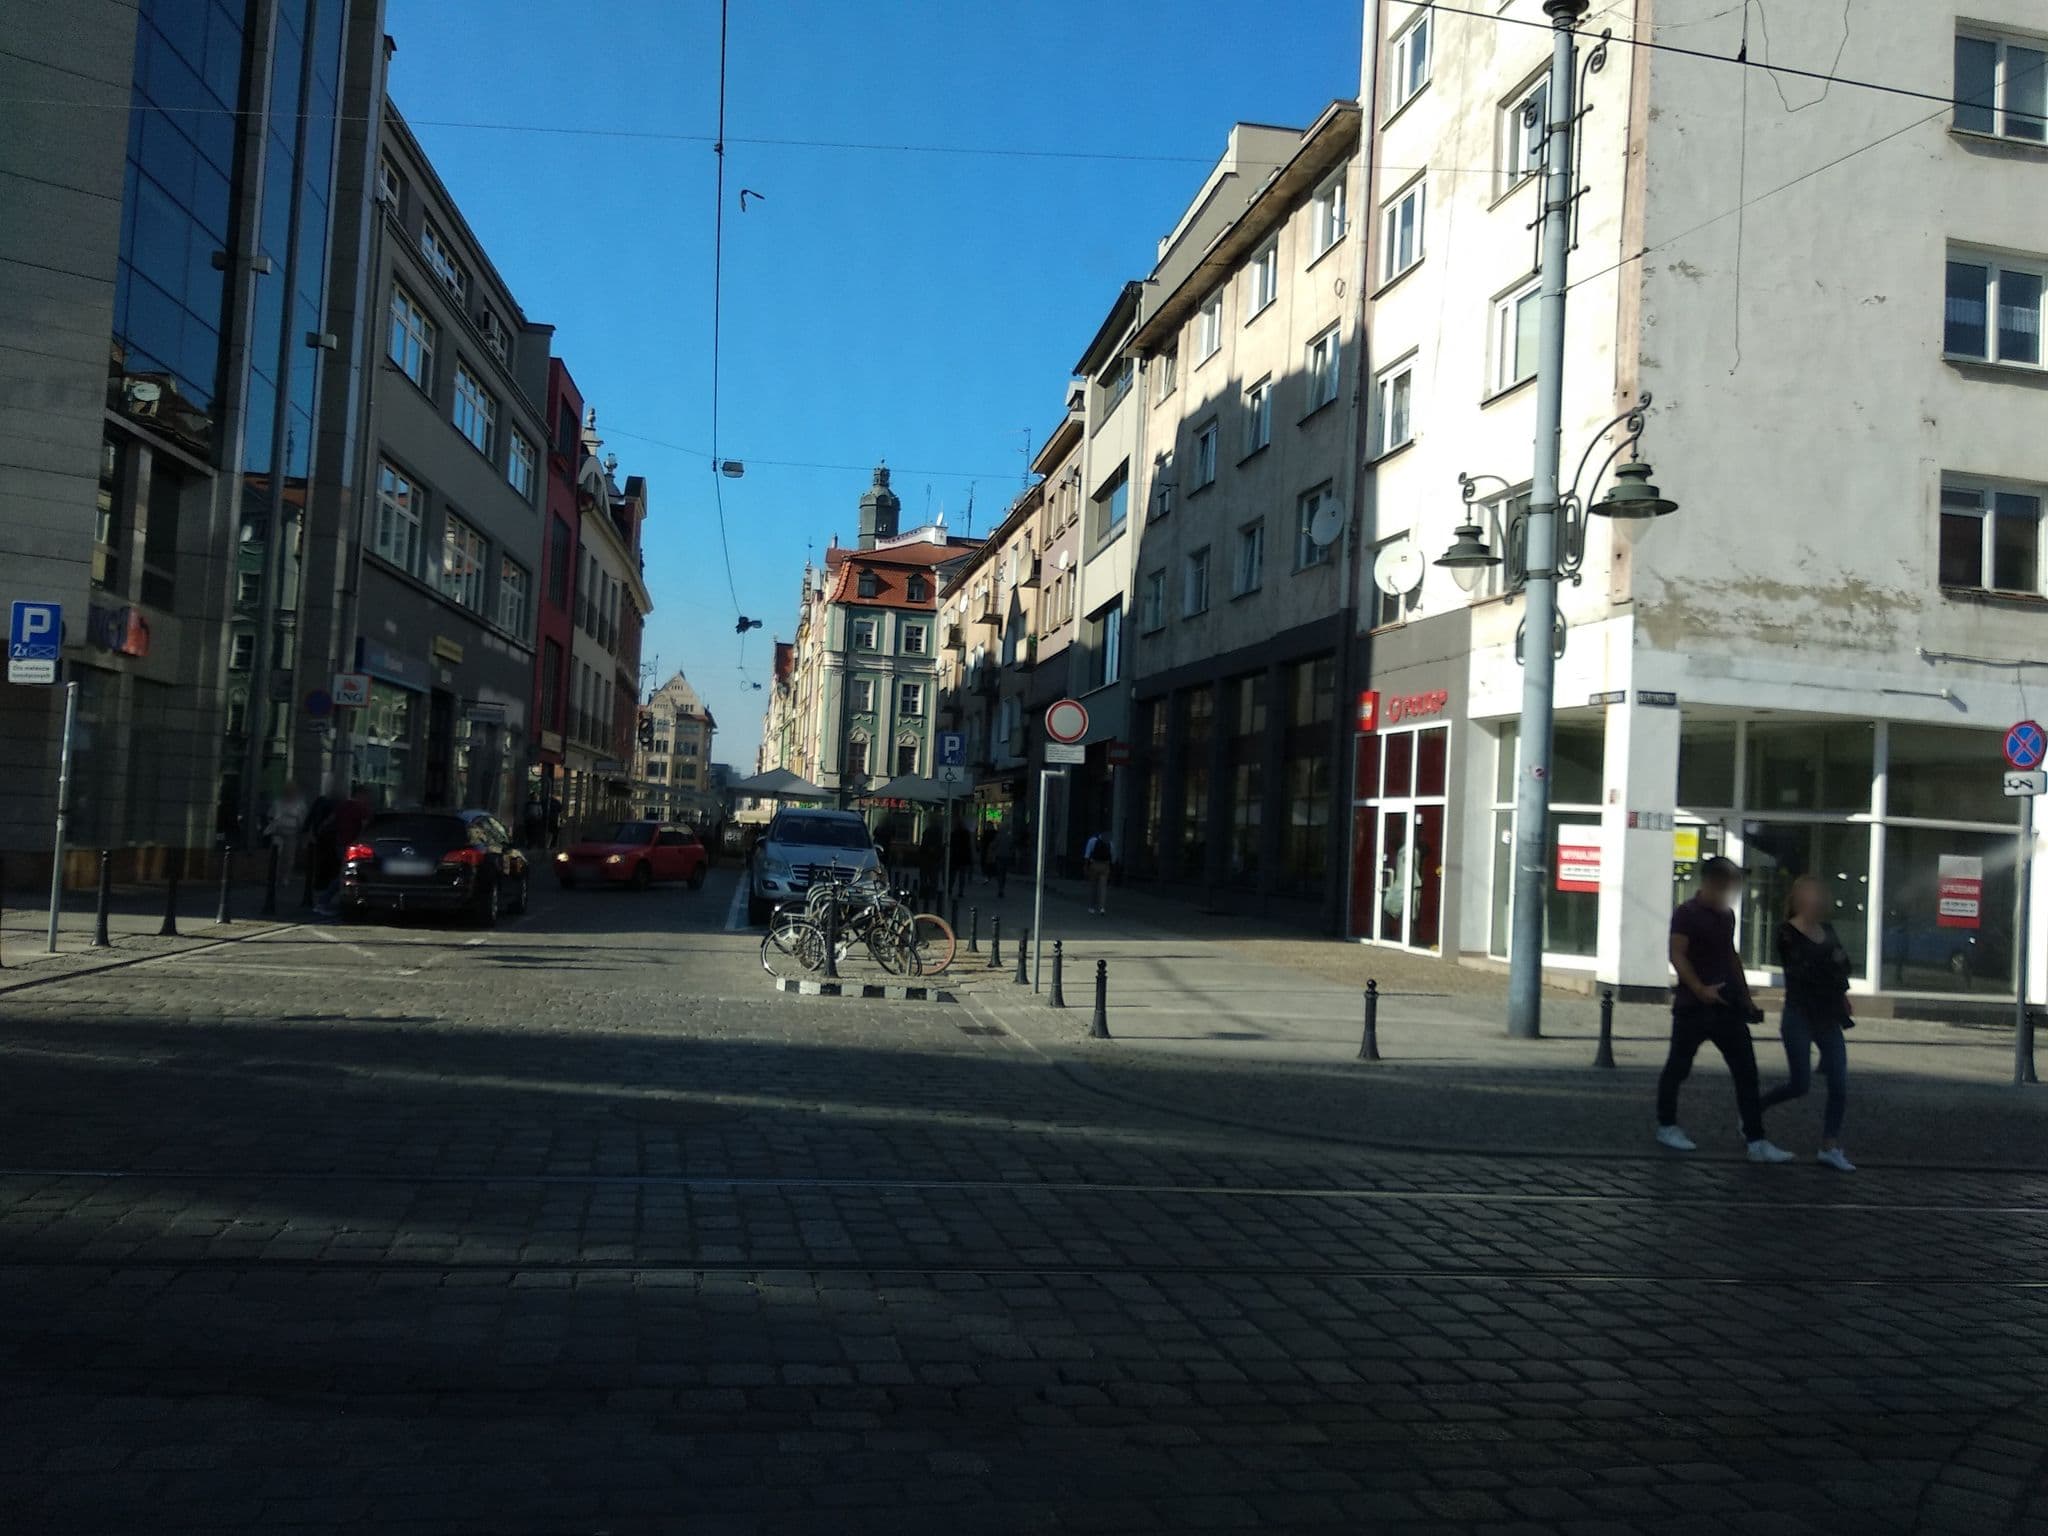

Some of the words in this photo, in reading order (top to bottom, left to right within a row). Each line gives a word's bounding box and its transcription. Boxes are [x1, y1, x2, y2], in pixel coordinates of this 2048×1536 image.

[22, 607, 51, 643] P
[13, 643, 28, 657] 2x
[336, 690, 363, 702] ING
[944, 736, 960, 756] P
